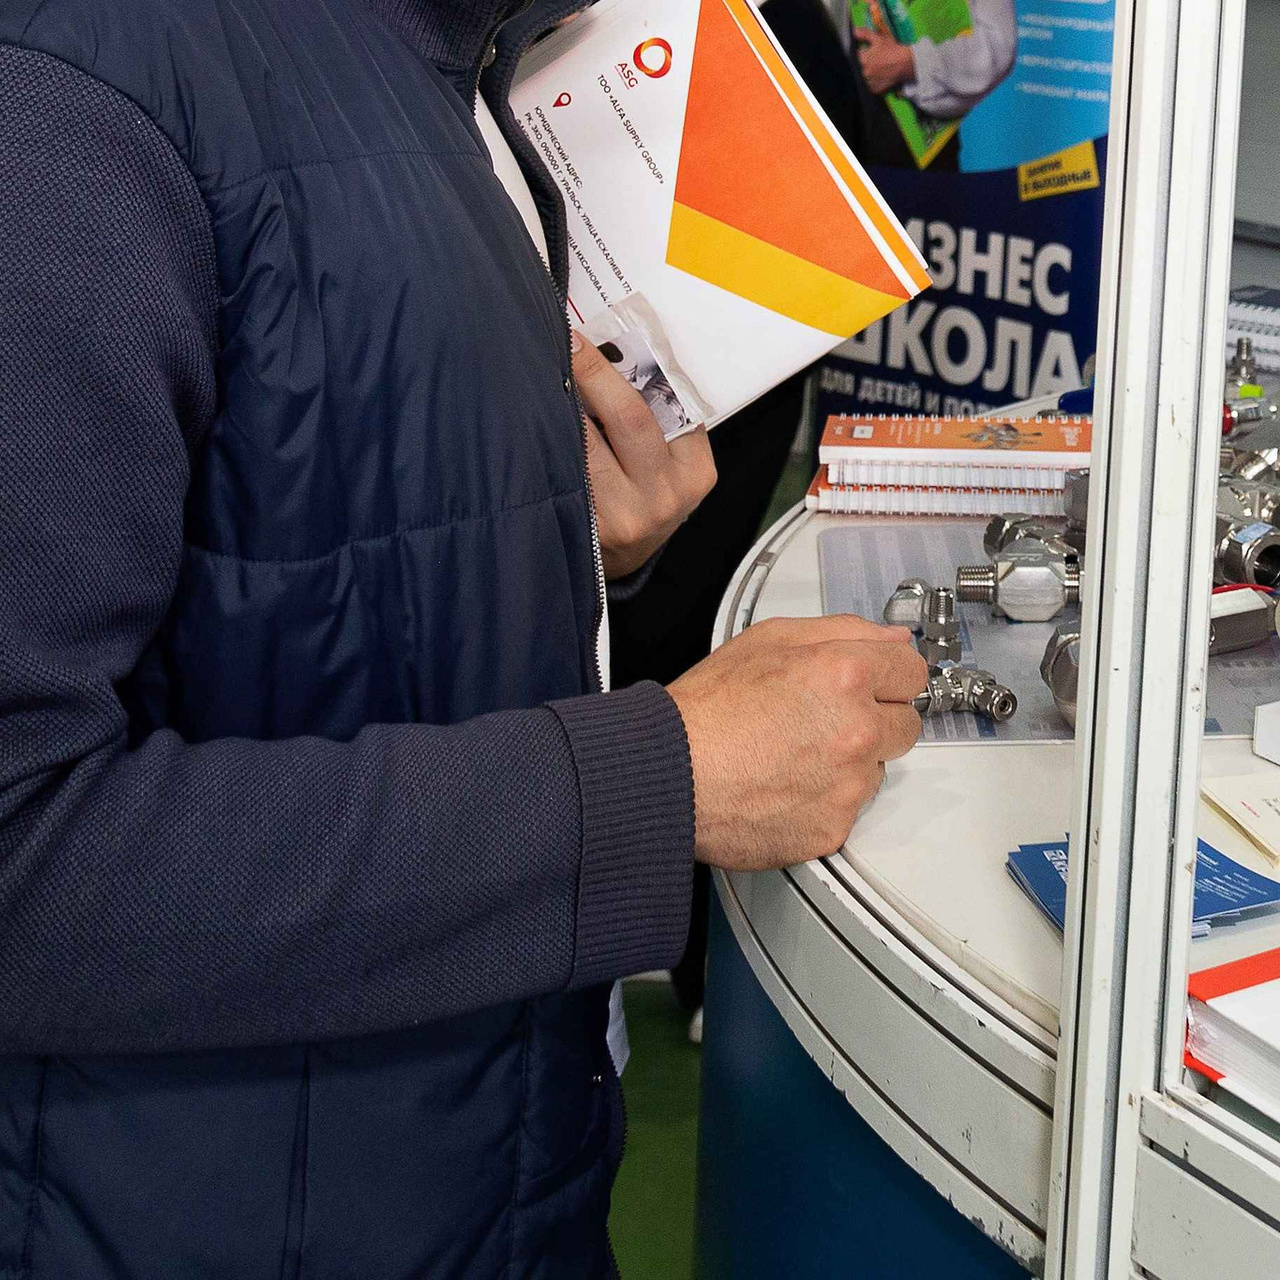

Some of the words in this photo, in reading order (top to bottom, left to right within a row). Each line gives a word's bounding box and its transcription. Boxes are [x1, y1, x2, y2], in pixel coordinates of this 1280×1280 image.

[616, 60, 638, 89] ASG
[532, 105, 569, 163] ЮРИДИЧЕСКИЙ
[563, 160, 584, 190] АДРЕС:
[607, 93, 627, 120] «ALFA
[622, 118, 644, 150] SUPPLY
[640, 149, 665, 186] GROUP»
[539, 142, 560, 171] 090000
[558, 176, 585, 215] УРАЛЬСК,
[580, 212, 599, 239] УЛИЦА
[594, 236, 625, 283] ЕСКАЛИЕВА
[574, 249, 603, 292] ИХСАНОВА
[857, 377, 922, 413] ДЕТЕЙ
[924, 390, 940, 414] И
